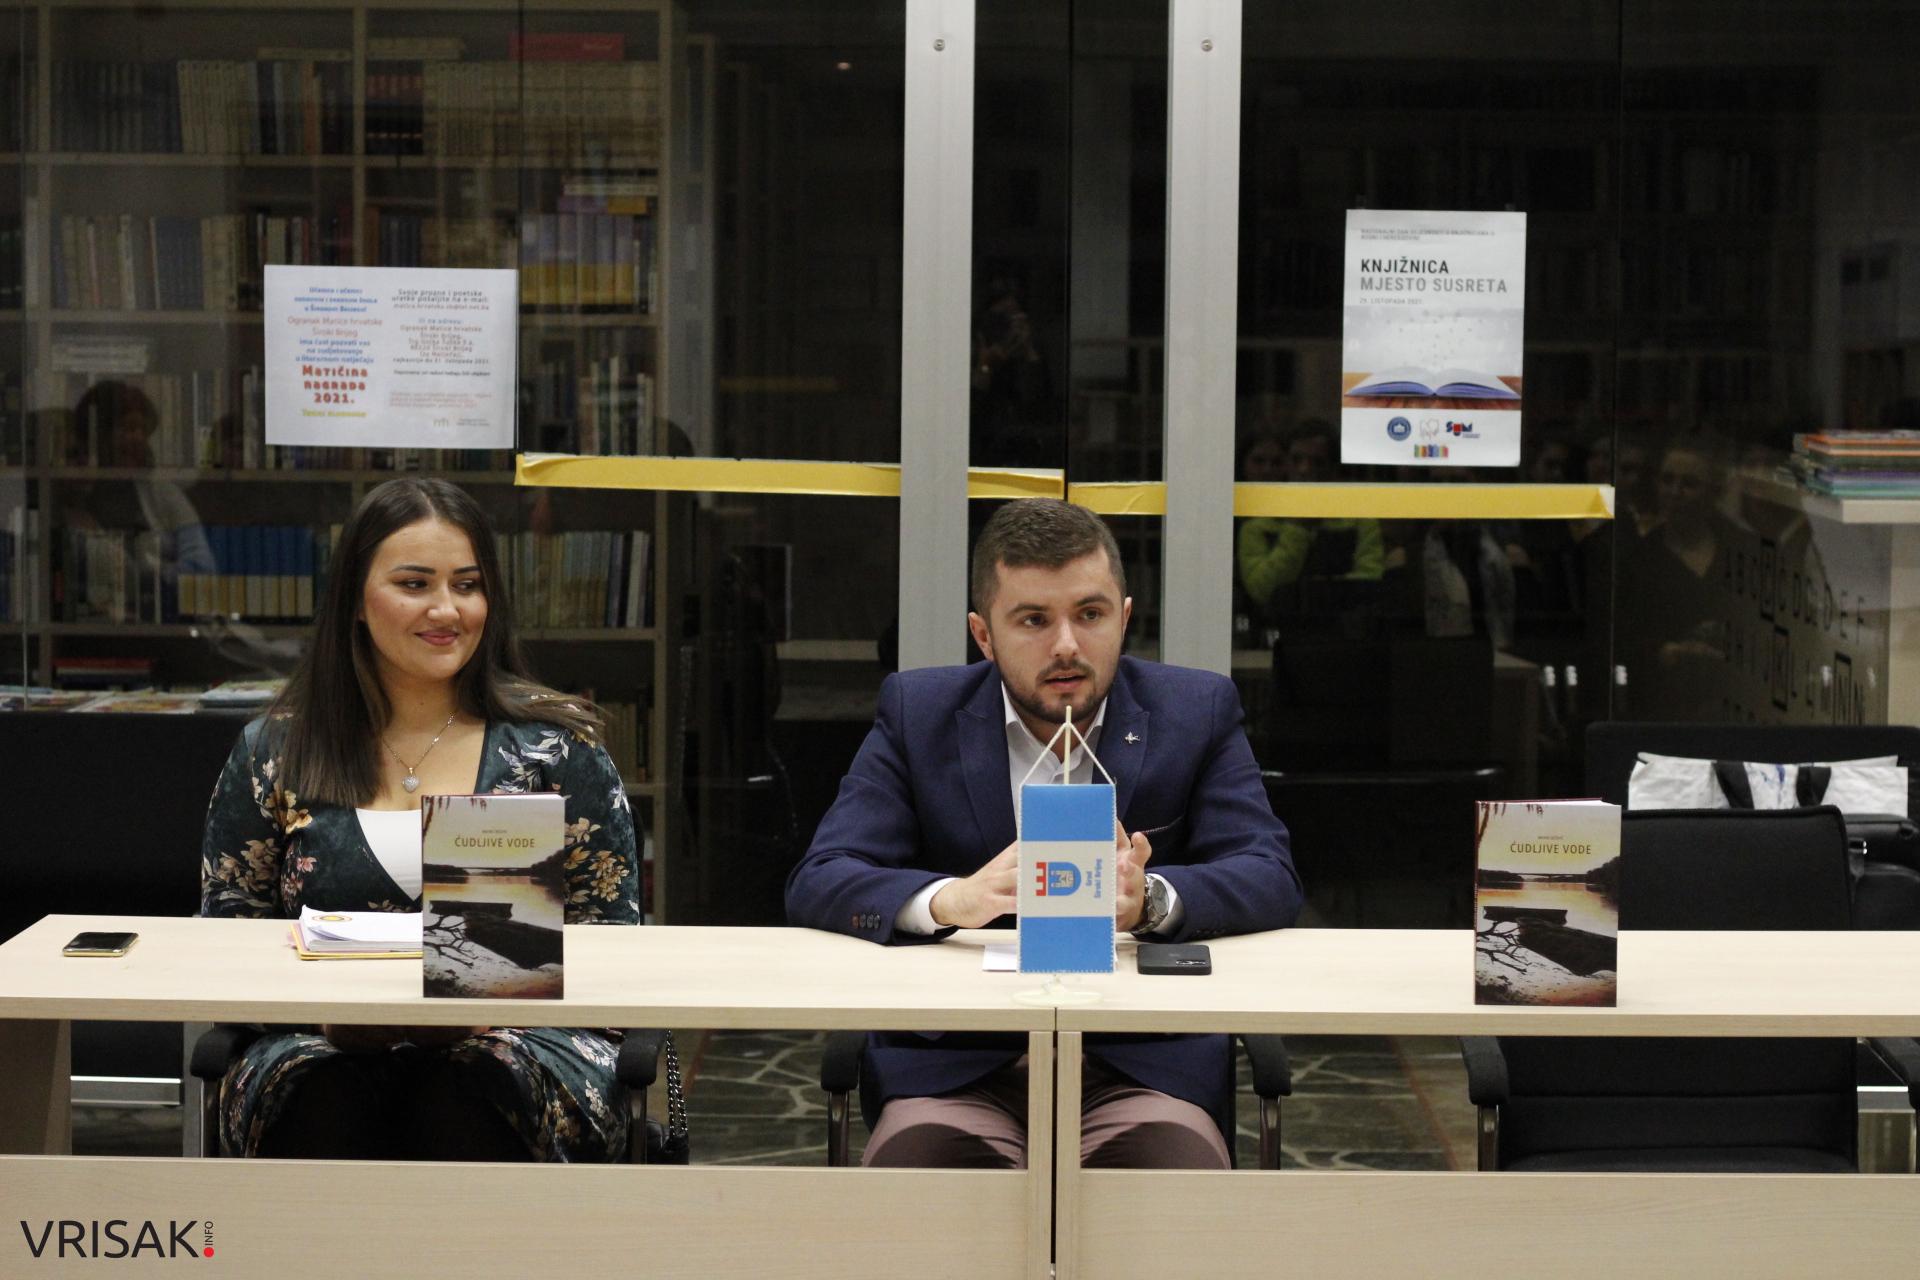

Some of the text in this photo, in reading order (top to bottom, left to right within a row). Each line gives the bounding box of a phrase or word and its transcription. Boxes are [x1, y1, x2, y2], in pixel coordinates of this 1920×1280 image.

[1361, 256, 1449, 274] KNJIŽNICA
[1360, 277, 1508, 293] MJESTO SUSRETA
[314, 393, 355, 403] 2021.
[507, 838, 535, 848] VODE
[1563, 844, 1591, 855] VODE
